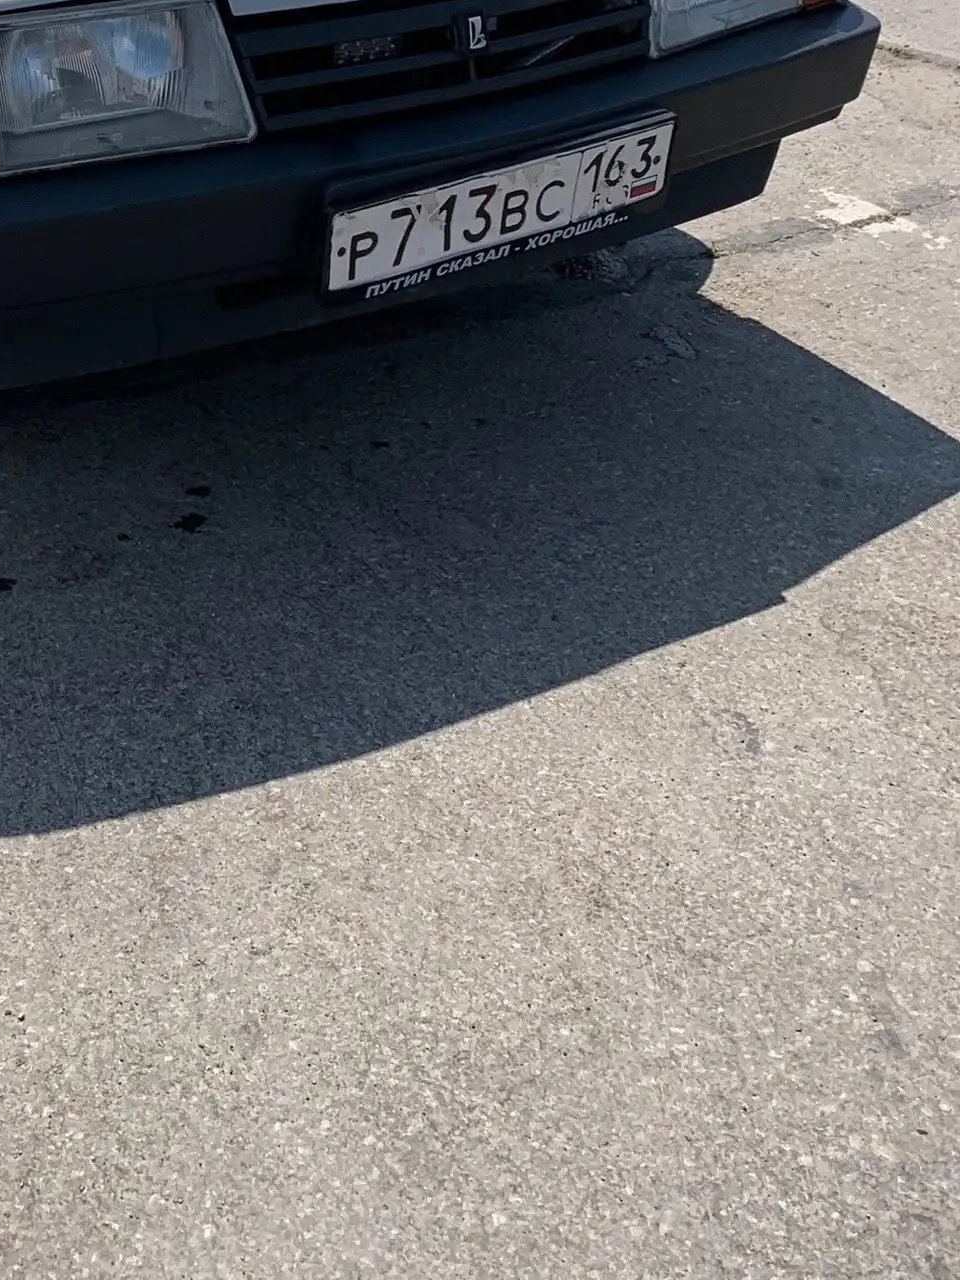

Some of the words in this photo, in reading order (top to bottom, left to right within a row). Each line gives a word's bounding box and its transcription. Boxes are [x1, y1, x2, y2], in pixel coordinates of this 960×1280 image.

[365, 269, 431, 299] ПУТИН
[436, 244, 511, 278] СКАЗАЛ
[524, 213, 628, 252] ХОРОШАЯ...
